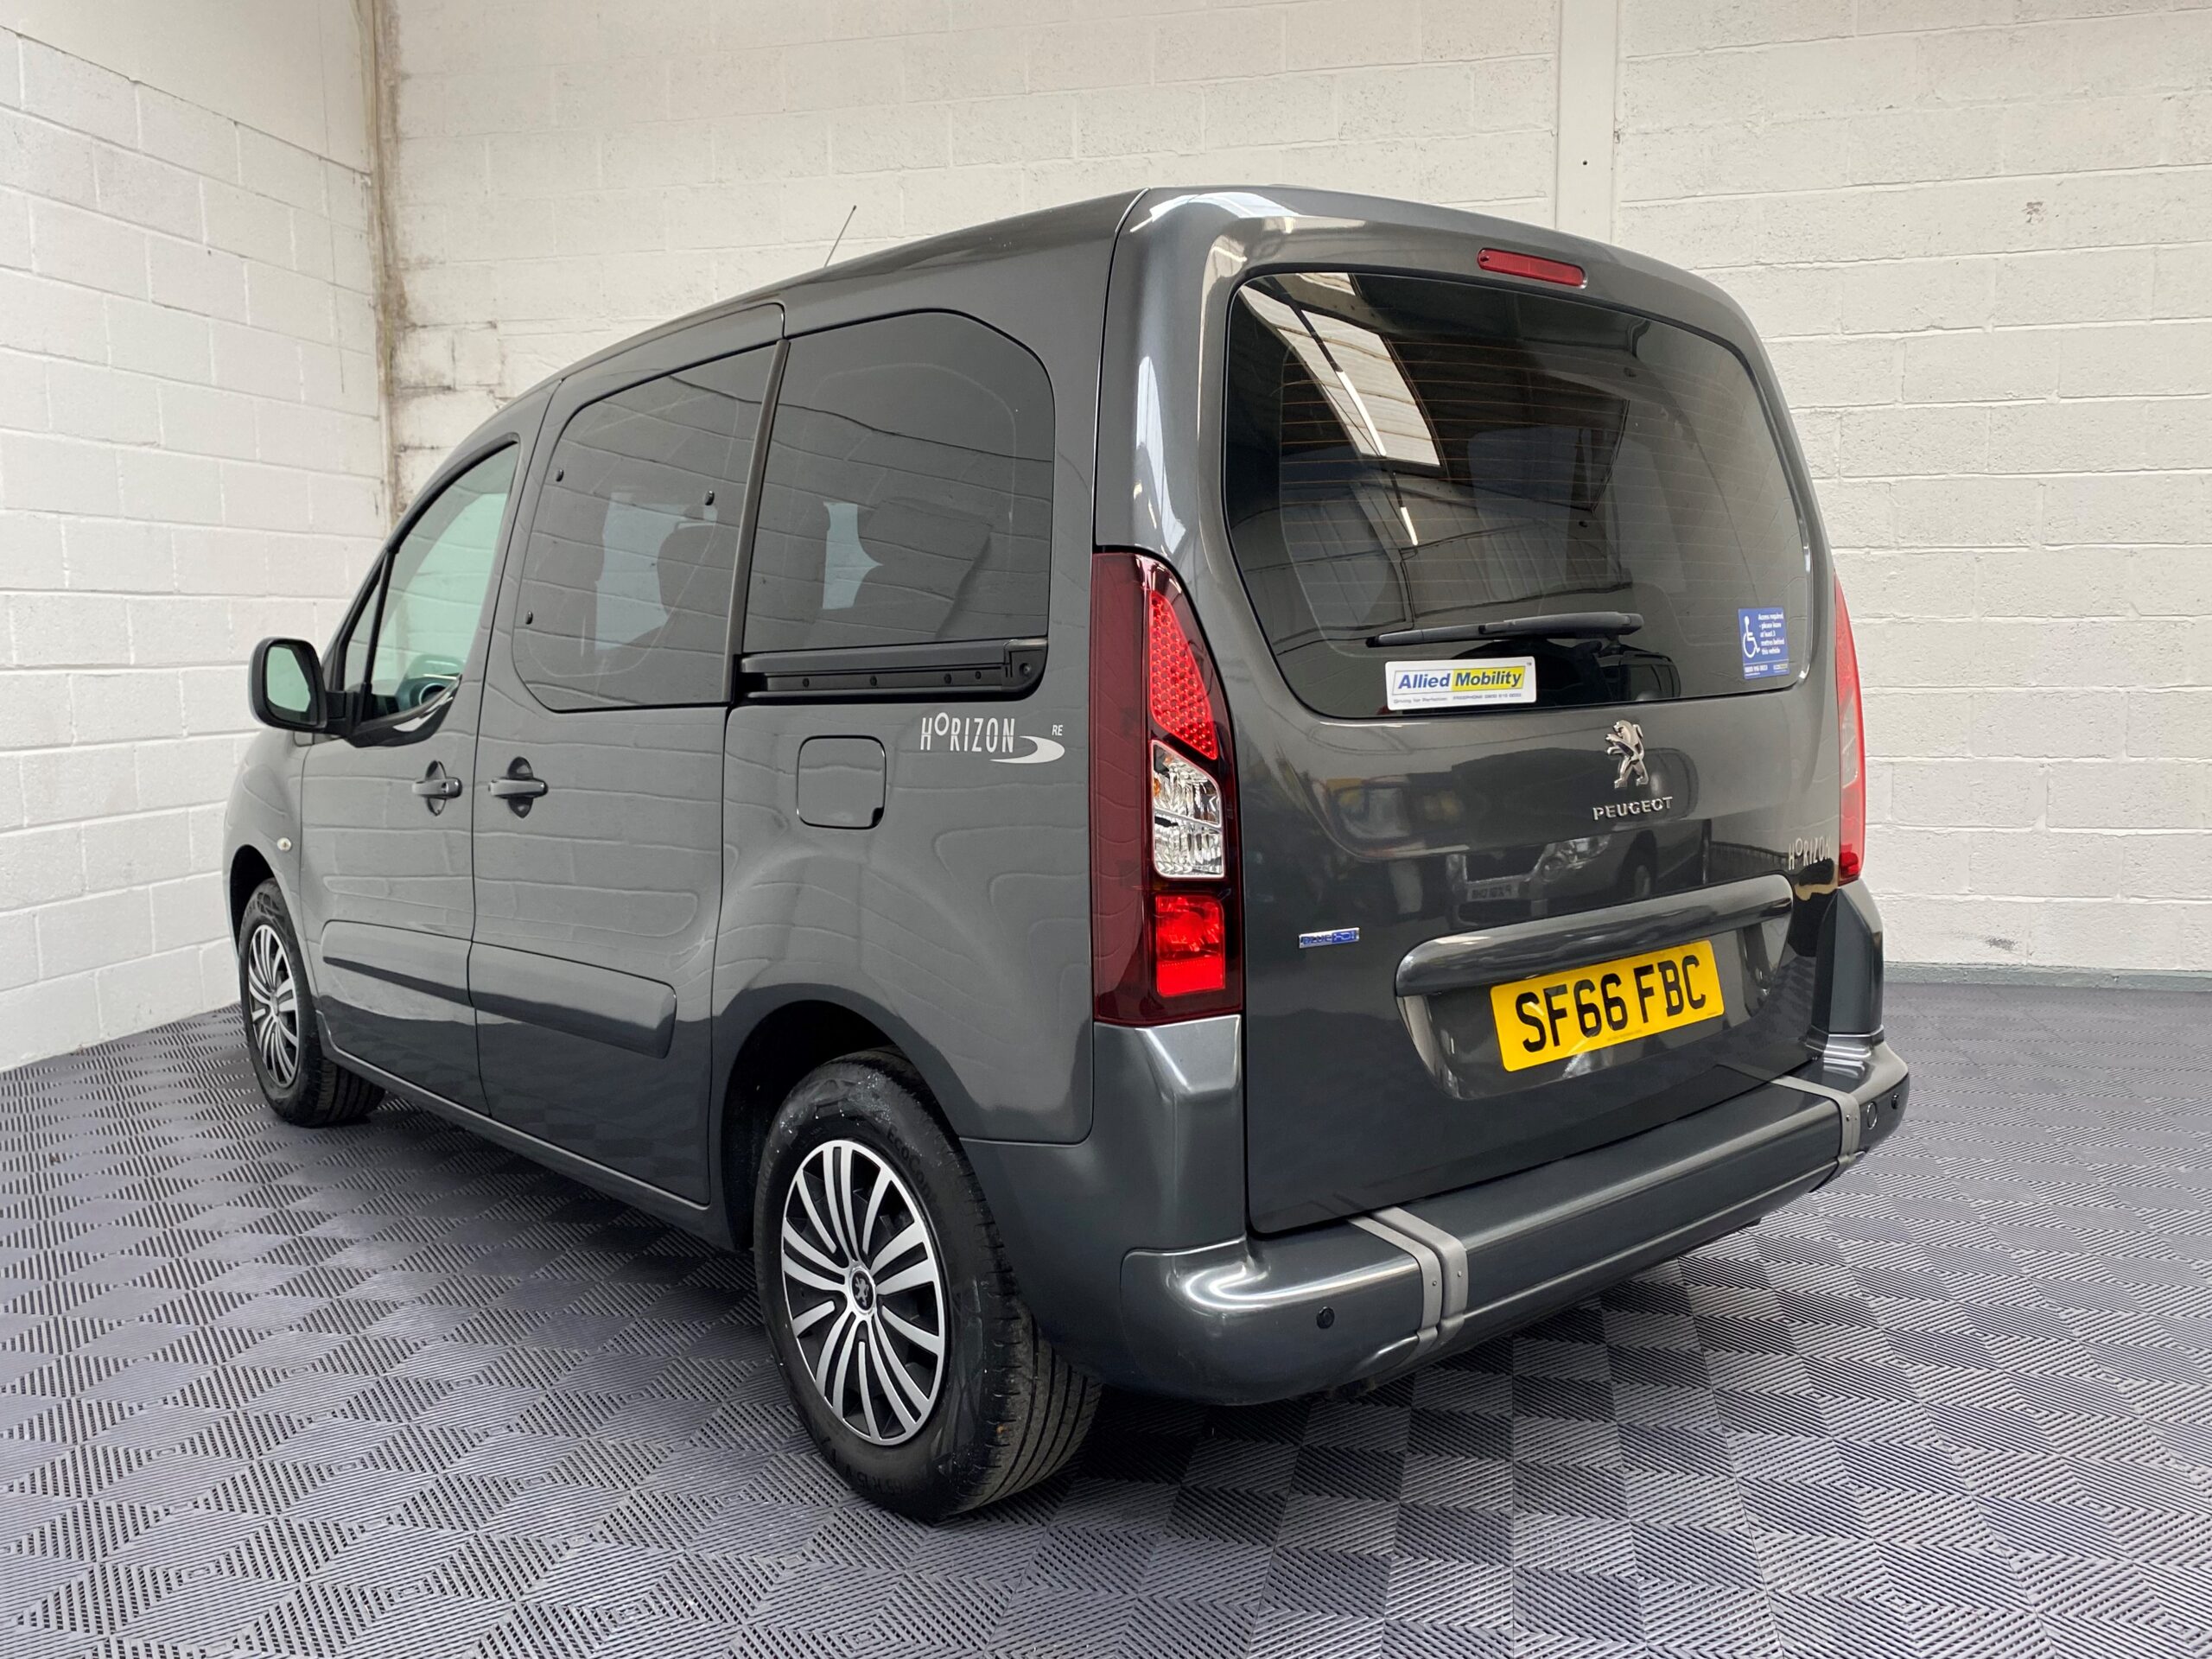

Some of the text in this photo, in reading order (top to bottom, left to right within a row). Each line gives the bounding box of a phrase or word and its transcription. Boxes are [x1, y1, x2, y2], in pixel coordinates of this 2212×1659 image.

[1770, 612, 1783, 621] required
[1397, 670, 1522, 690] Allied Mobility
[919, 711, 1064, 753] HORIZON RE
[1592, 796, 1674, 821] PEUGEOT
[1788, 836, 1831, 871] HORIZON
[1515, 954, 1707, 1053] SF66 FBC
